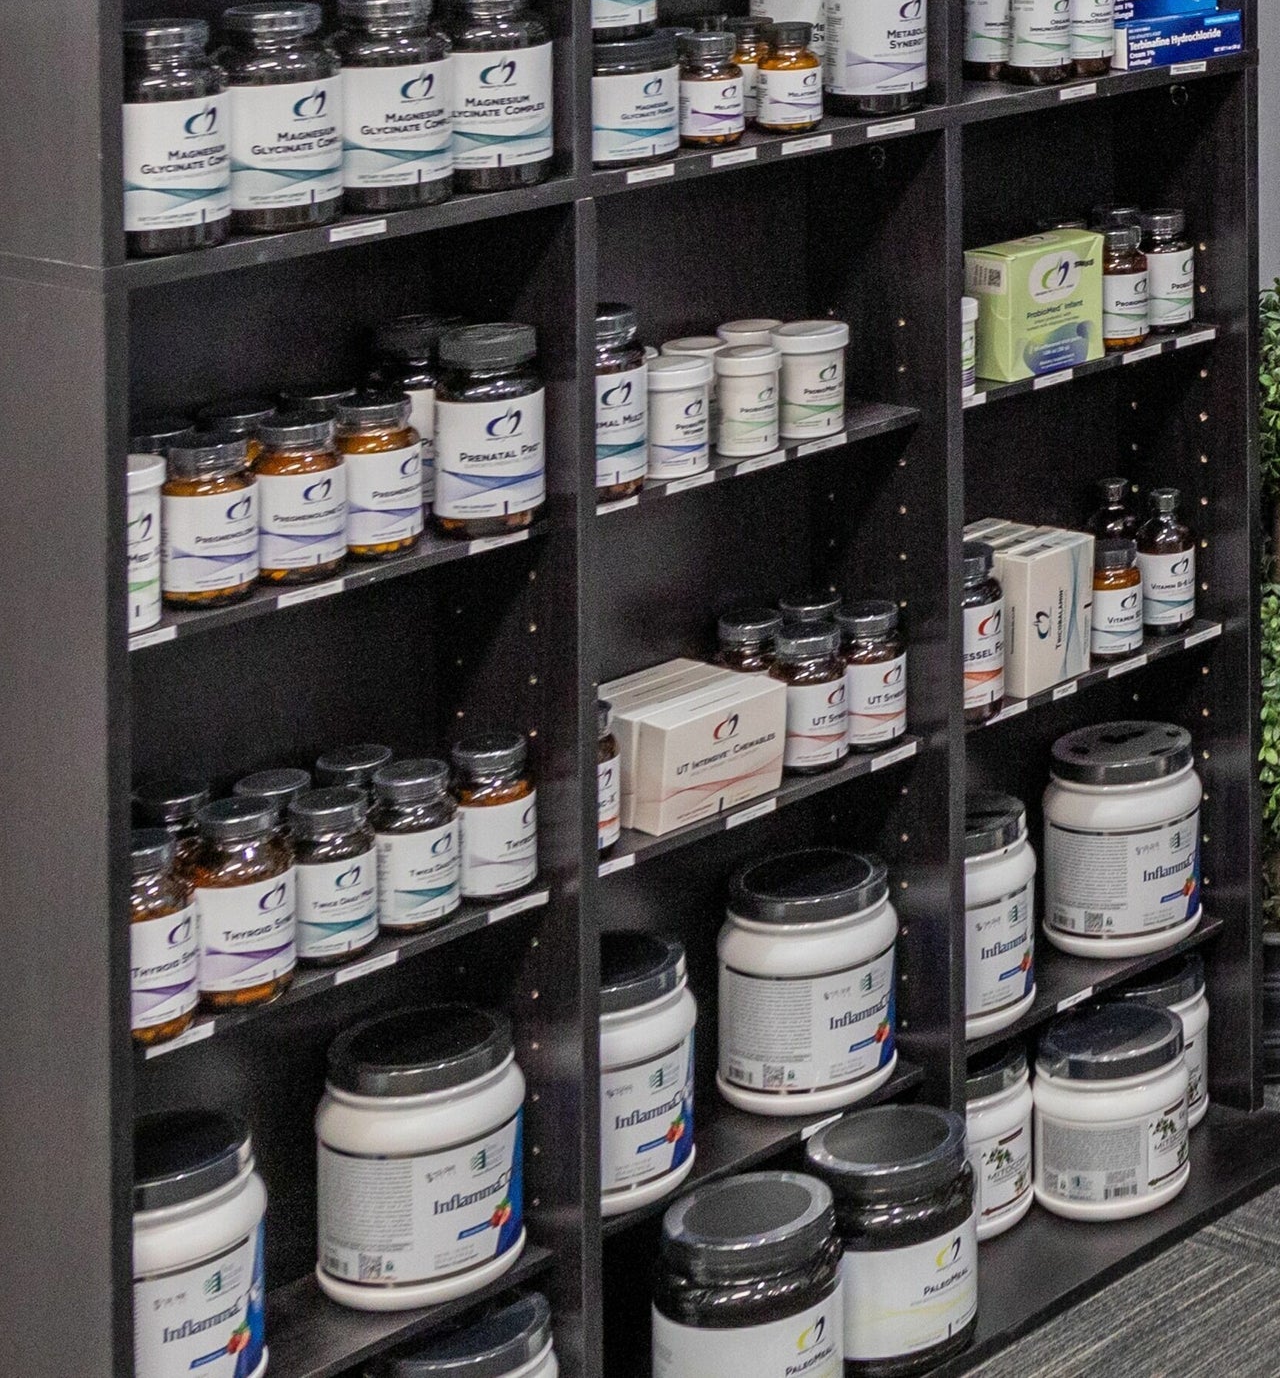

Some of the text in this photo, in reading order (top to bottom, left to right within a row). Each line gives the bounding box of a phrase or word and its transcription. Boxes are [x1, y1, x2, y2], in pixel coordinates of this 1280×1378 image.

[1129, 28, 1221, 50] Terbinafine Hydrochloride
[676, 765, 688, 775] UT
[1142, 853, 1196, 883] InflammaC
[829, 992, 891, 1030] InflammaC
[615, 1090, 684, 1129] InflammaC
[433, 1168, 514, 1216] InflammaC
